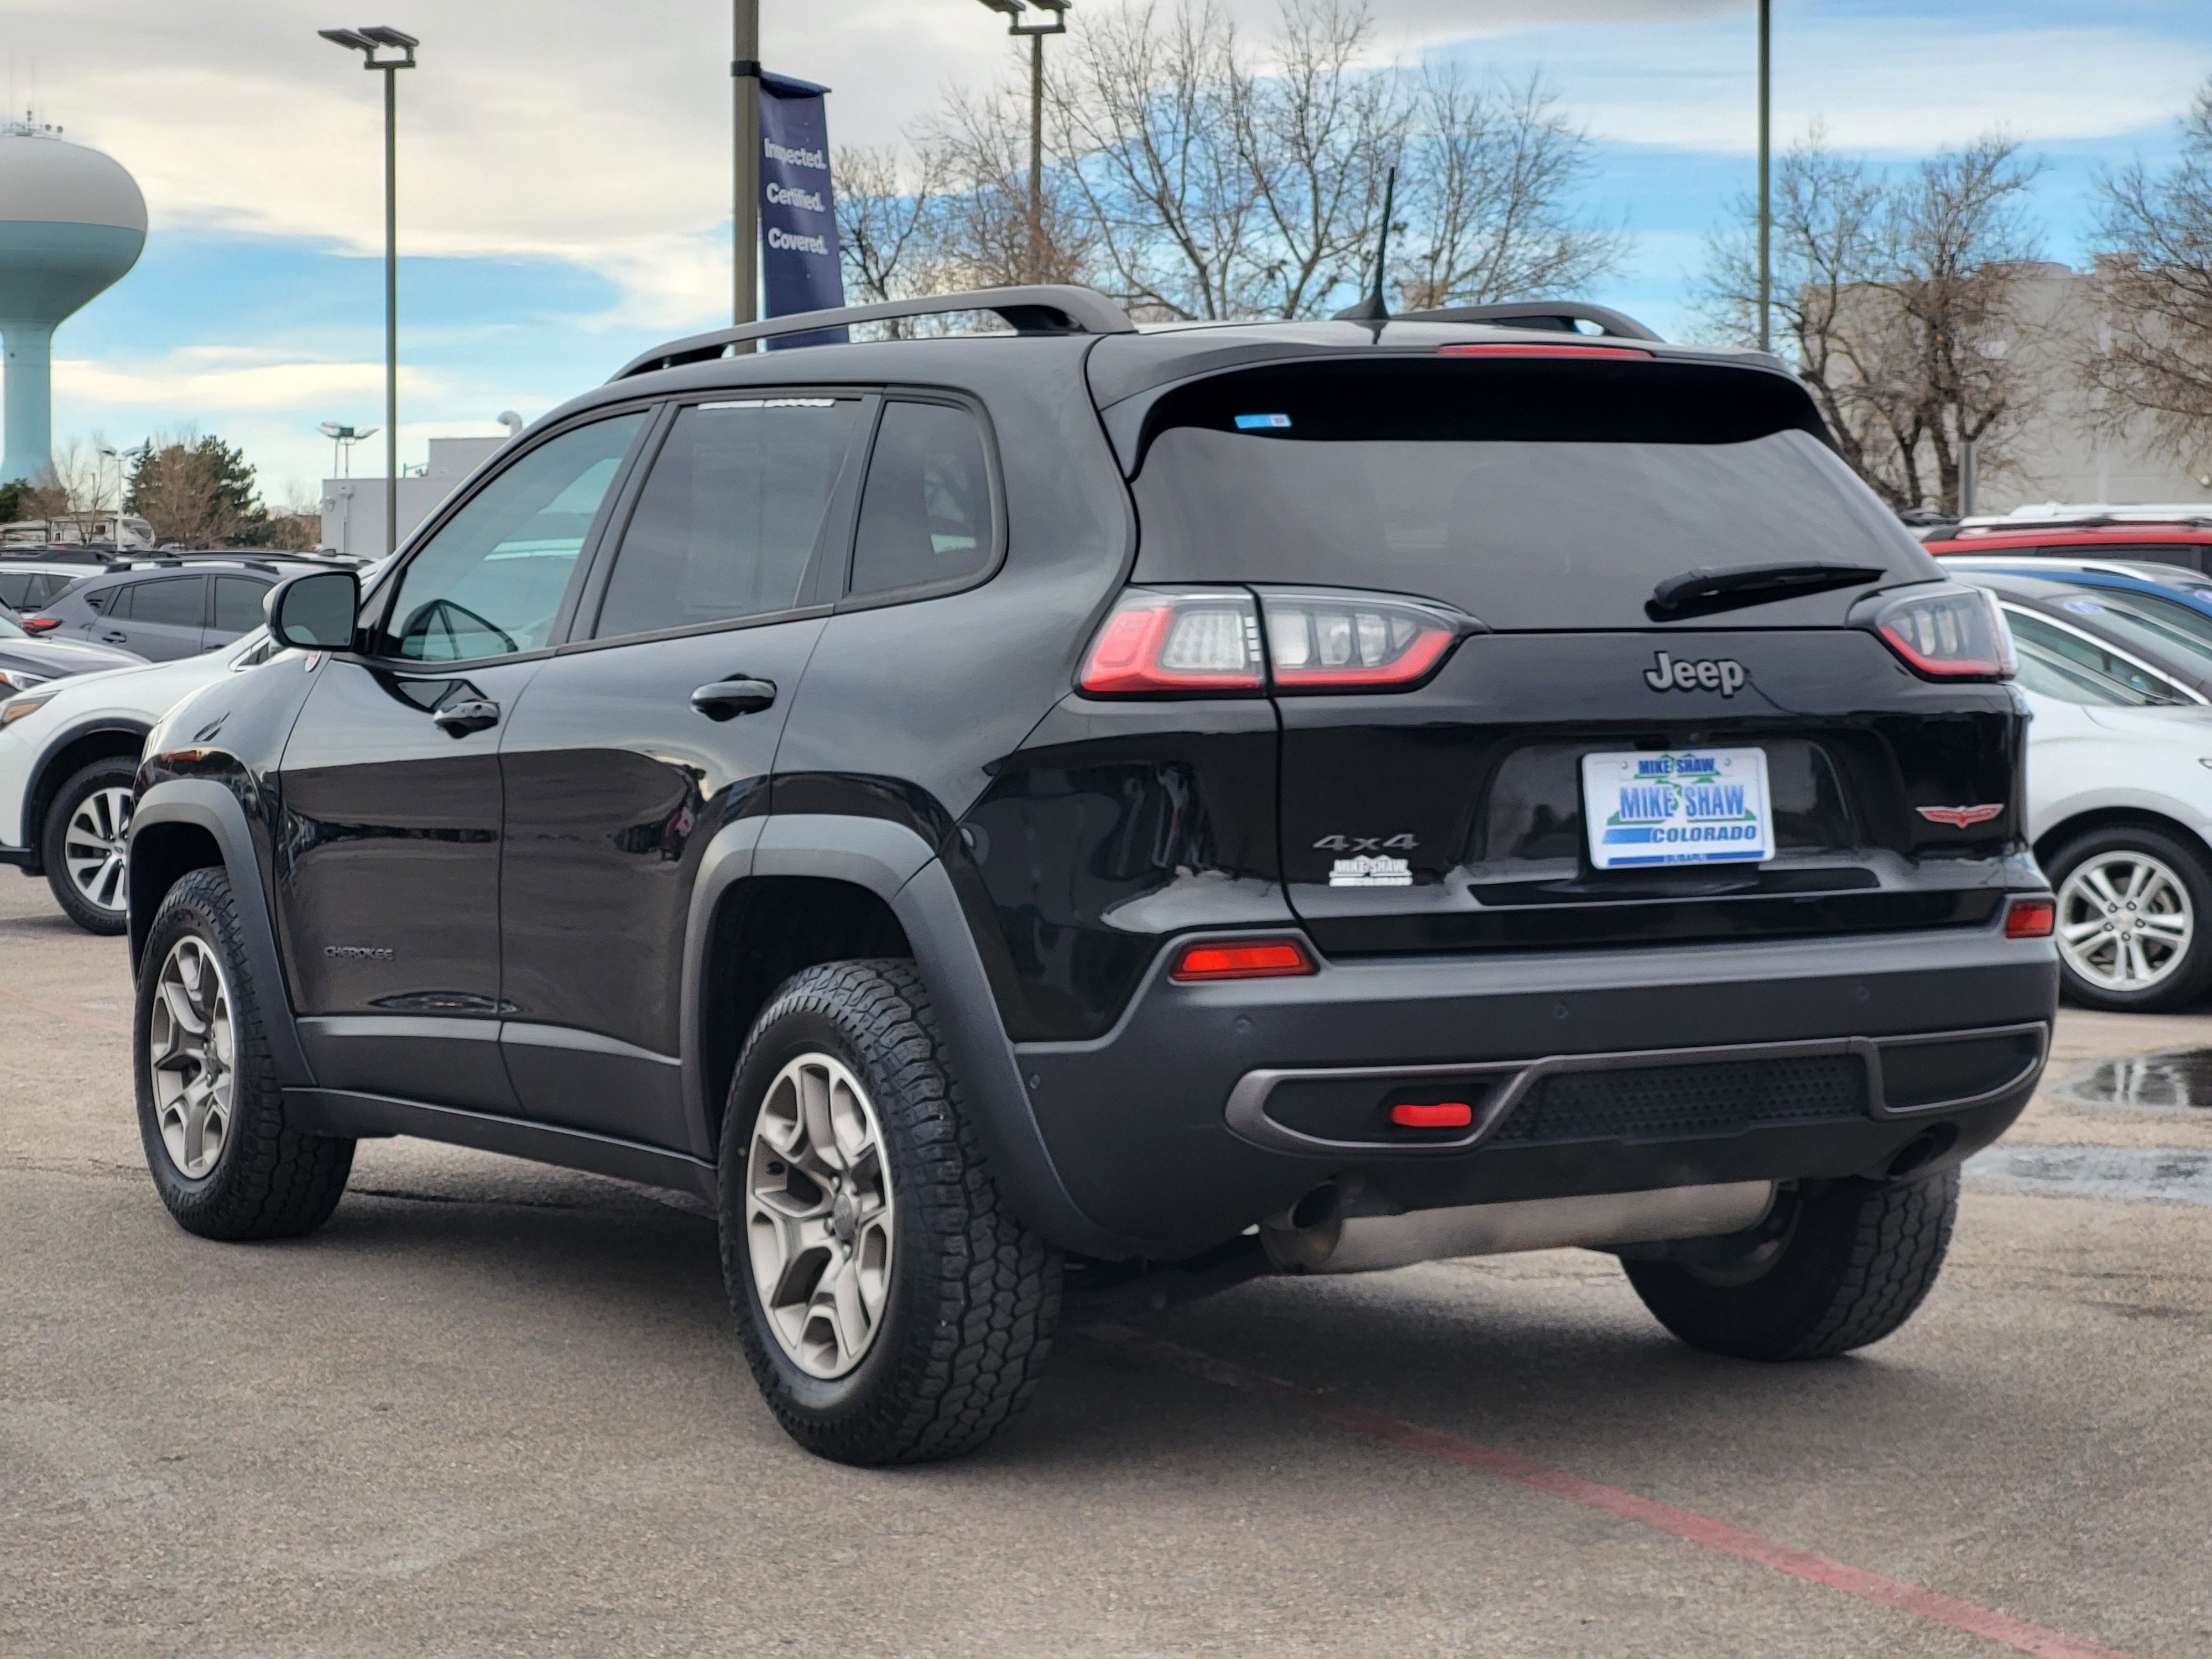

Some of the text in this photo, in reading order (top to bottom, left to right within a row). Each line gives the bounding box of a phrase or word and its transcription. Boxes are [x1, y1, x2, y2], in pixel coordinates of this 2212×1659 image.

[764, 137, 827, 170] Inspected.
[766, 182, 826, 212] Certified.
[768, 227, 829, 255] Covered.
[1642, 650, 1744, 700] Jeep
[1639, 758, 1715, 774] MIKE SHAW
[1620, 784, 1744, 818] MIKE SHAW
[1652, 826, 1757, 843] COLORADO
[324, 946, 394, 961] CHEROKEE
